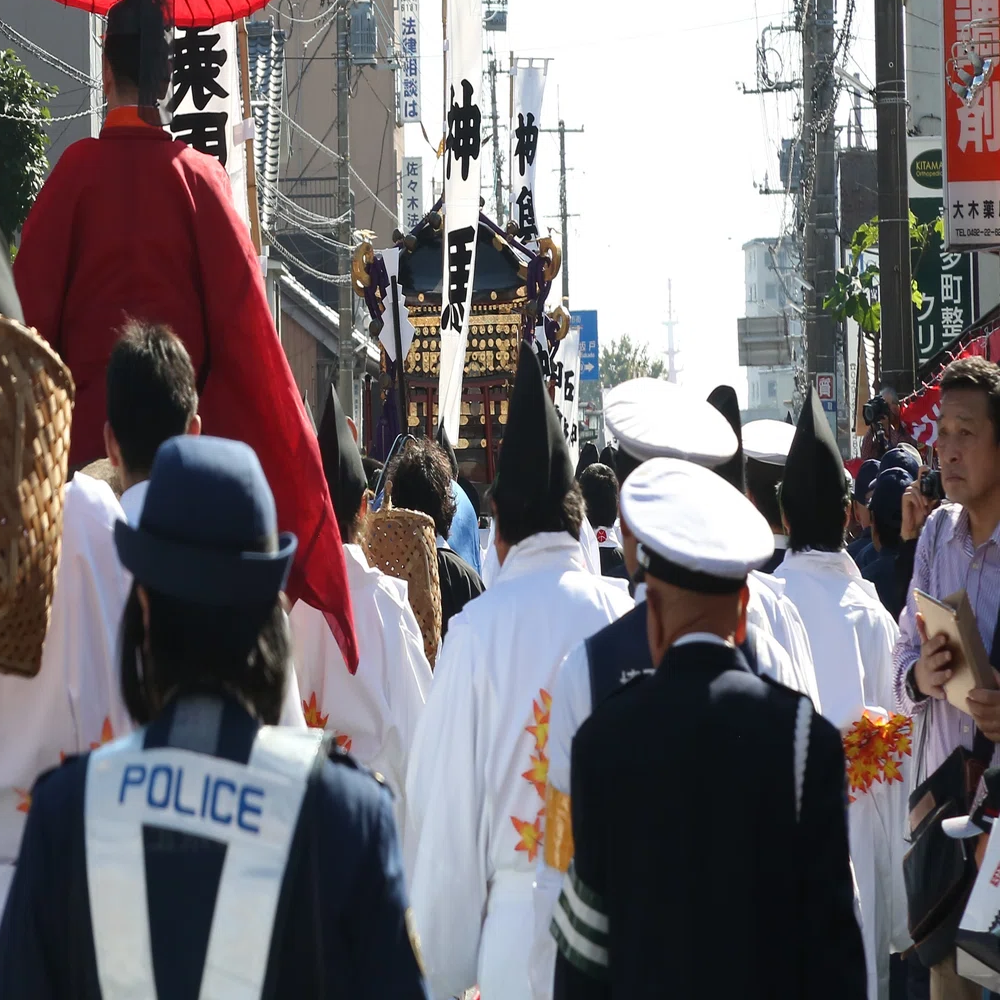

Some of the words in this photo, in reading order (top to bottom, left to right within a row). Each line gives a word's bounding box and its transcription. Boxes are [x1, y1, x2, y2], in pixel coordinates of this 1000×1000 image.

[402, 17, 418, 118] 法律相談は
[952, 200, 1000, 220] 大木薬
[955, 228, 966, 237] TEL
[917, 293, 935, 363] クリ
[118, 763, 266, 834] POLICE
